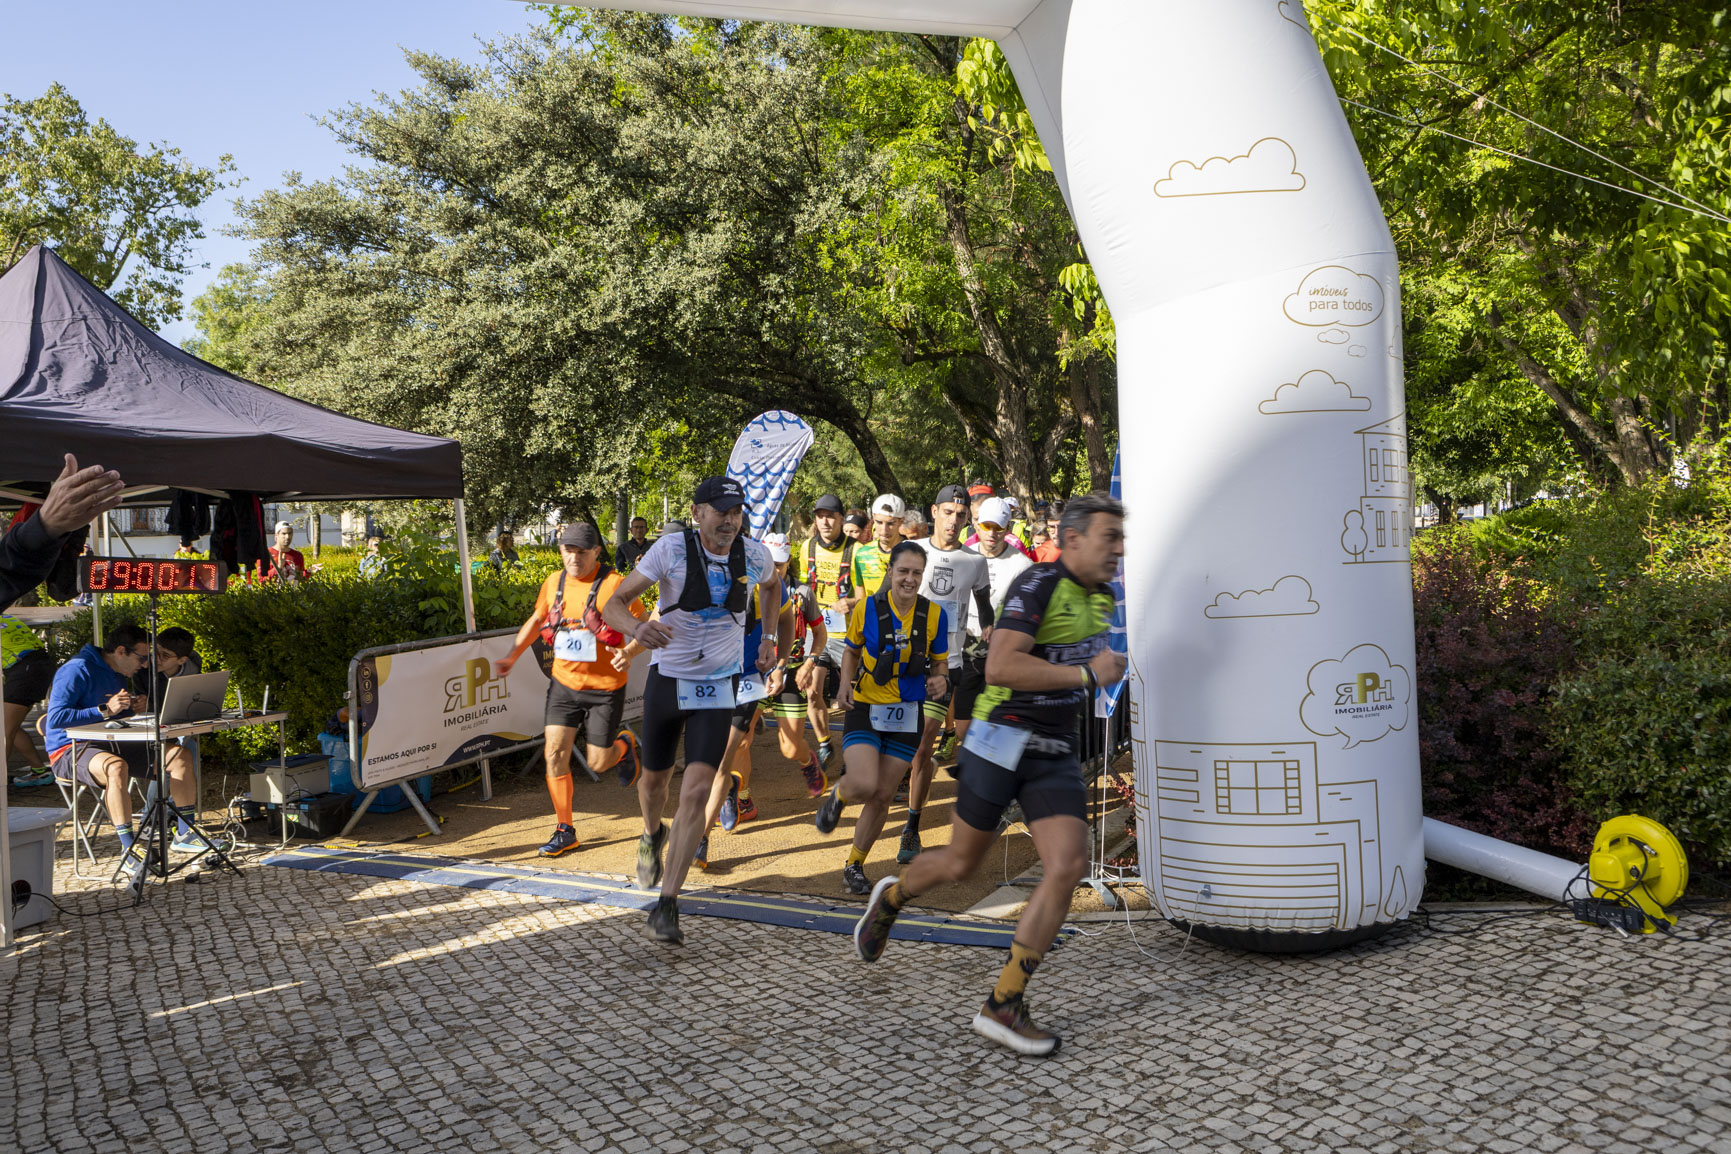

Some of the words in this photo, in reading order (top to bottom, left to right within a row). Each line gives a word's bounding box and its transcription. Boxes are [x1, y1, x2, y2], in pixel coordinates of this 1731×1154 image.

[1309, 300, 1338, 312] para
[1343, 299, 1373, 312] todos
[89, 561, 217, 590] 09:00:17
[566, 638, 583, 651] 20
[695, 685, 717, 698] 82
[444, 704, 508, 728] IMOBILIÁRIA
[886, 706, 904, 721] 70
[1334, 704, 1393, 715] IMOBILIÁRIA
[367, 751, 400, 766] ESTAMOS
[400, 747, 417, 758] AQUI
[417, 744, 431, 754] POR
[431, 742, 437, 750] SI
